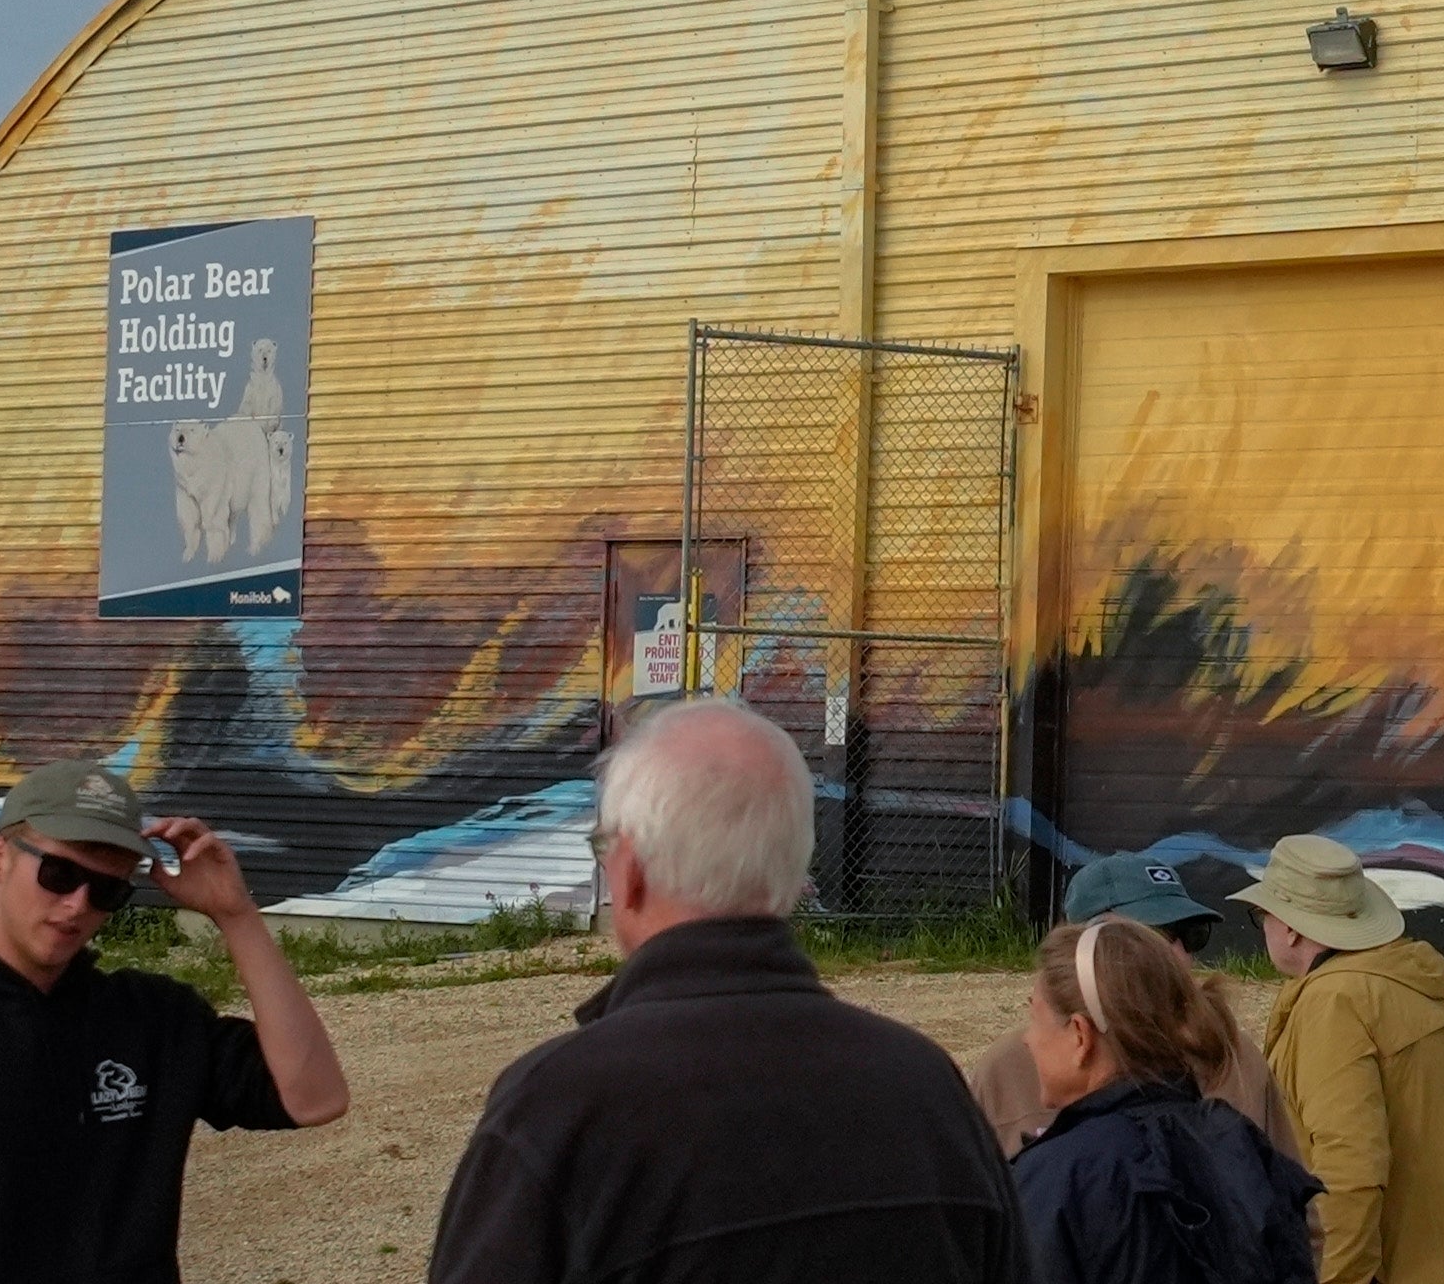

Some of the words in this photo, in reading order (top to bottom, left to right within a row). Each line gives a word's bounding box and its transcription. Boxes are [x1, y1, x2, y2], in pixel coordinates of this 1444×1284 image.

[120, 265, 196, 305] Polar
[204, 262, 275, 299] Bear
[118, 312, 235, 358] Holding
[116, 362, 227, 409] Facility
[229, 590, 273, 605] Manitoba
[658, 634, 681, 647] ENT
[649, 673, 674, 684] STAFF
